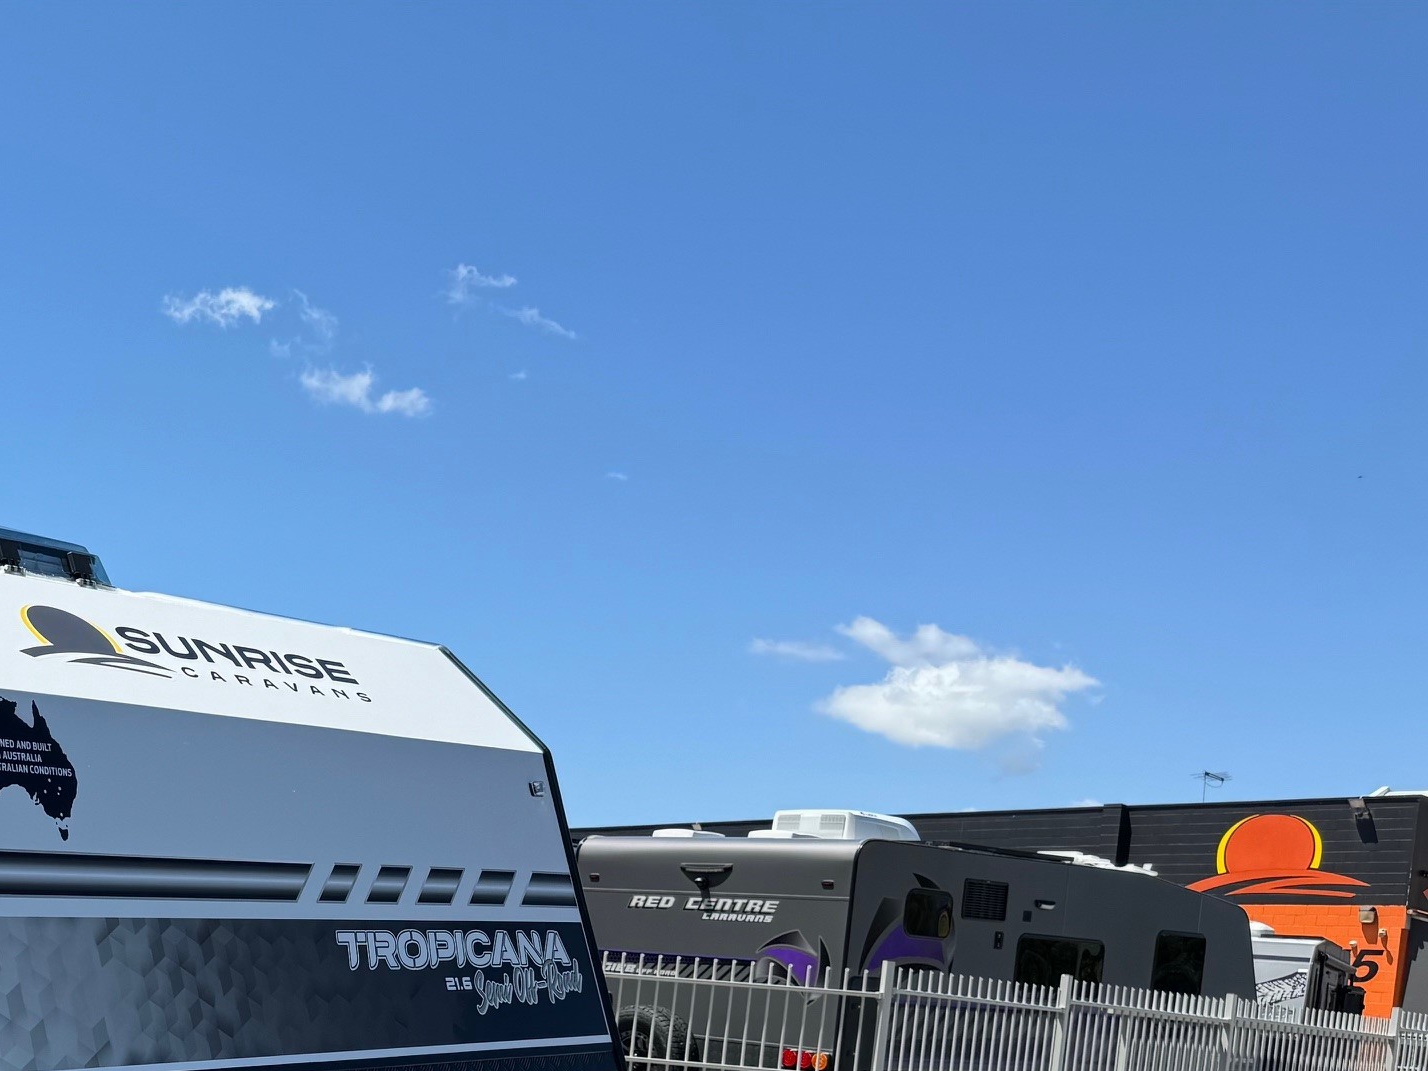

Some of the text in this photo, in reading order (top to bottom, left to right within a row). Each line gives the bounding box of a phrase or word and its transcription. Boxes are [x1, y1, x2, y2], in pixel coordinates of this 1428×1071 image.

[115, 626, 359, 685] SUNRISE
[181, 666, 372, 703] CARAVANS
[2, 751, 43, 763] AUSTRALIA
[16, 740, 31, 750] AND
[32, 742, 52, 752] BUILT
[29, 765, 73, 777] CONDITIONS
[628, 895, 780, 913] RED CENTRE
[701, 913, 774, 923] CARAVANS
[335, 929, 572, 970] TROPICANA
[1352, 949, 1385, 983] 5
[445, 977, 473, 991] 21.6
[474, 970, 513, 1015] Semi
